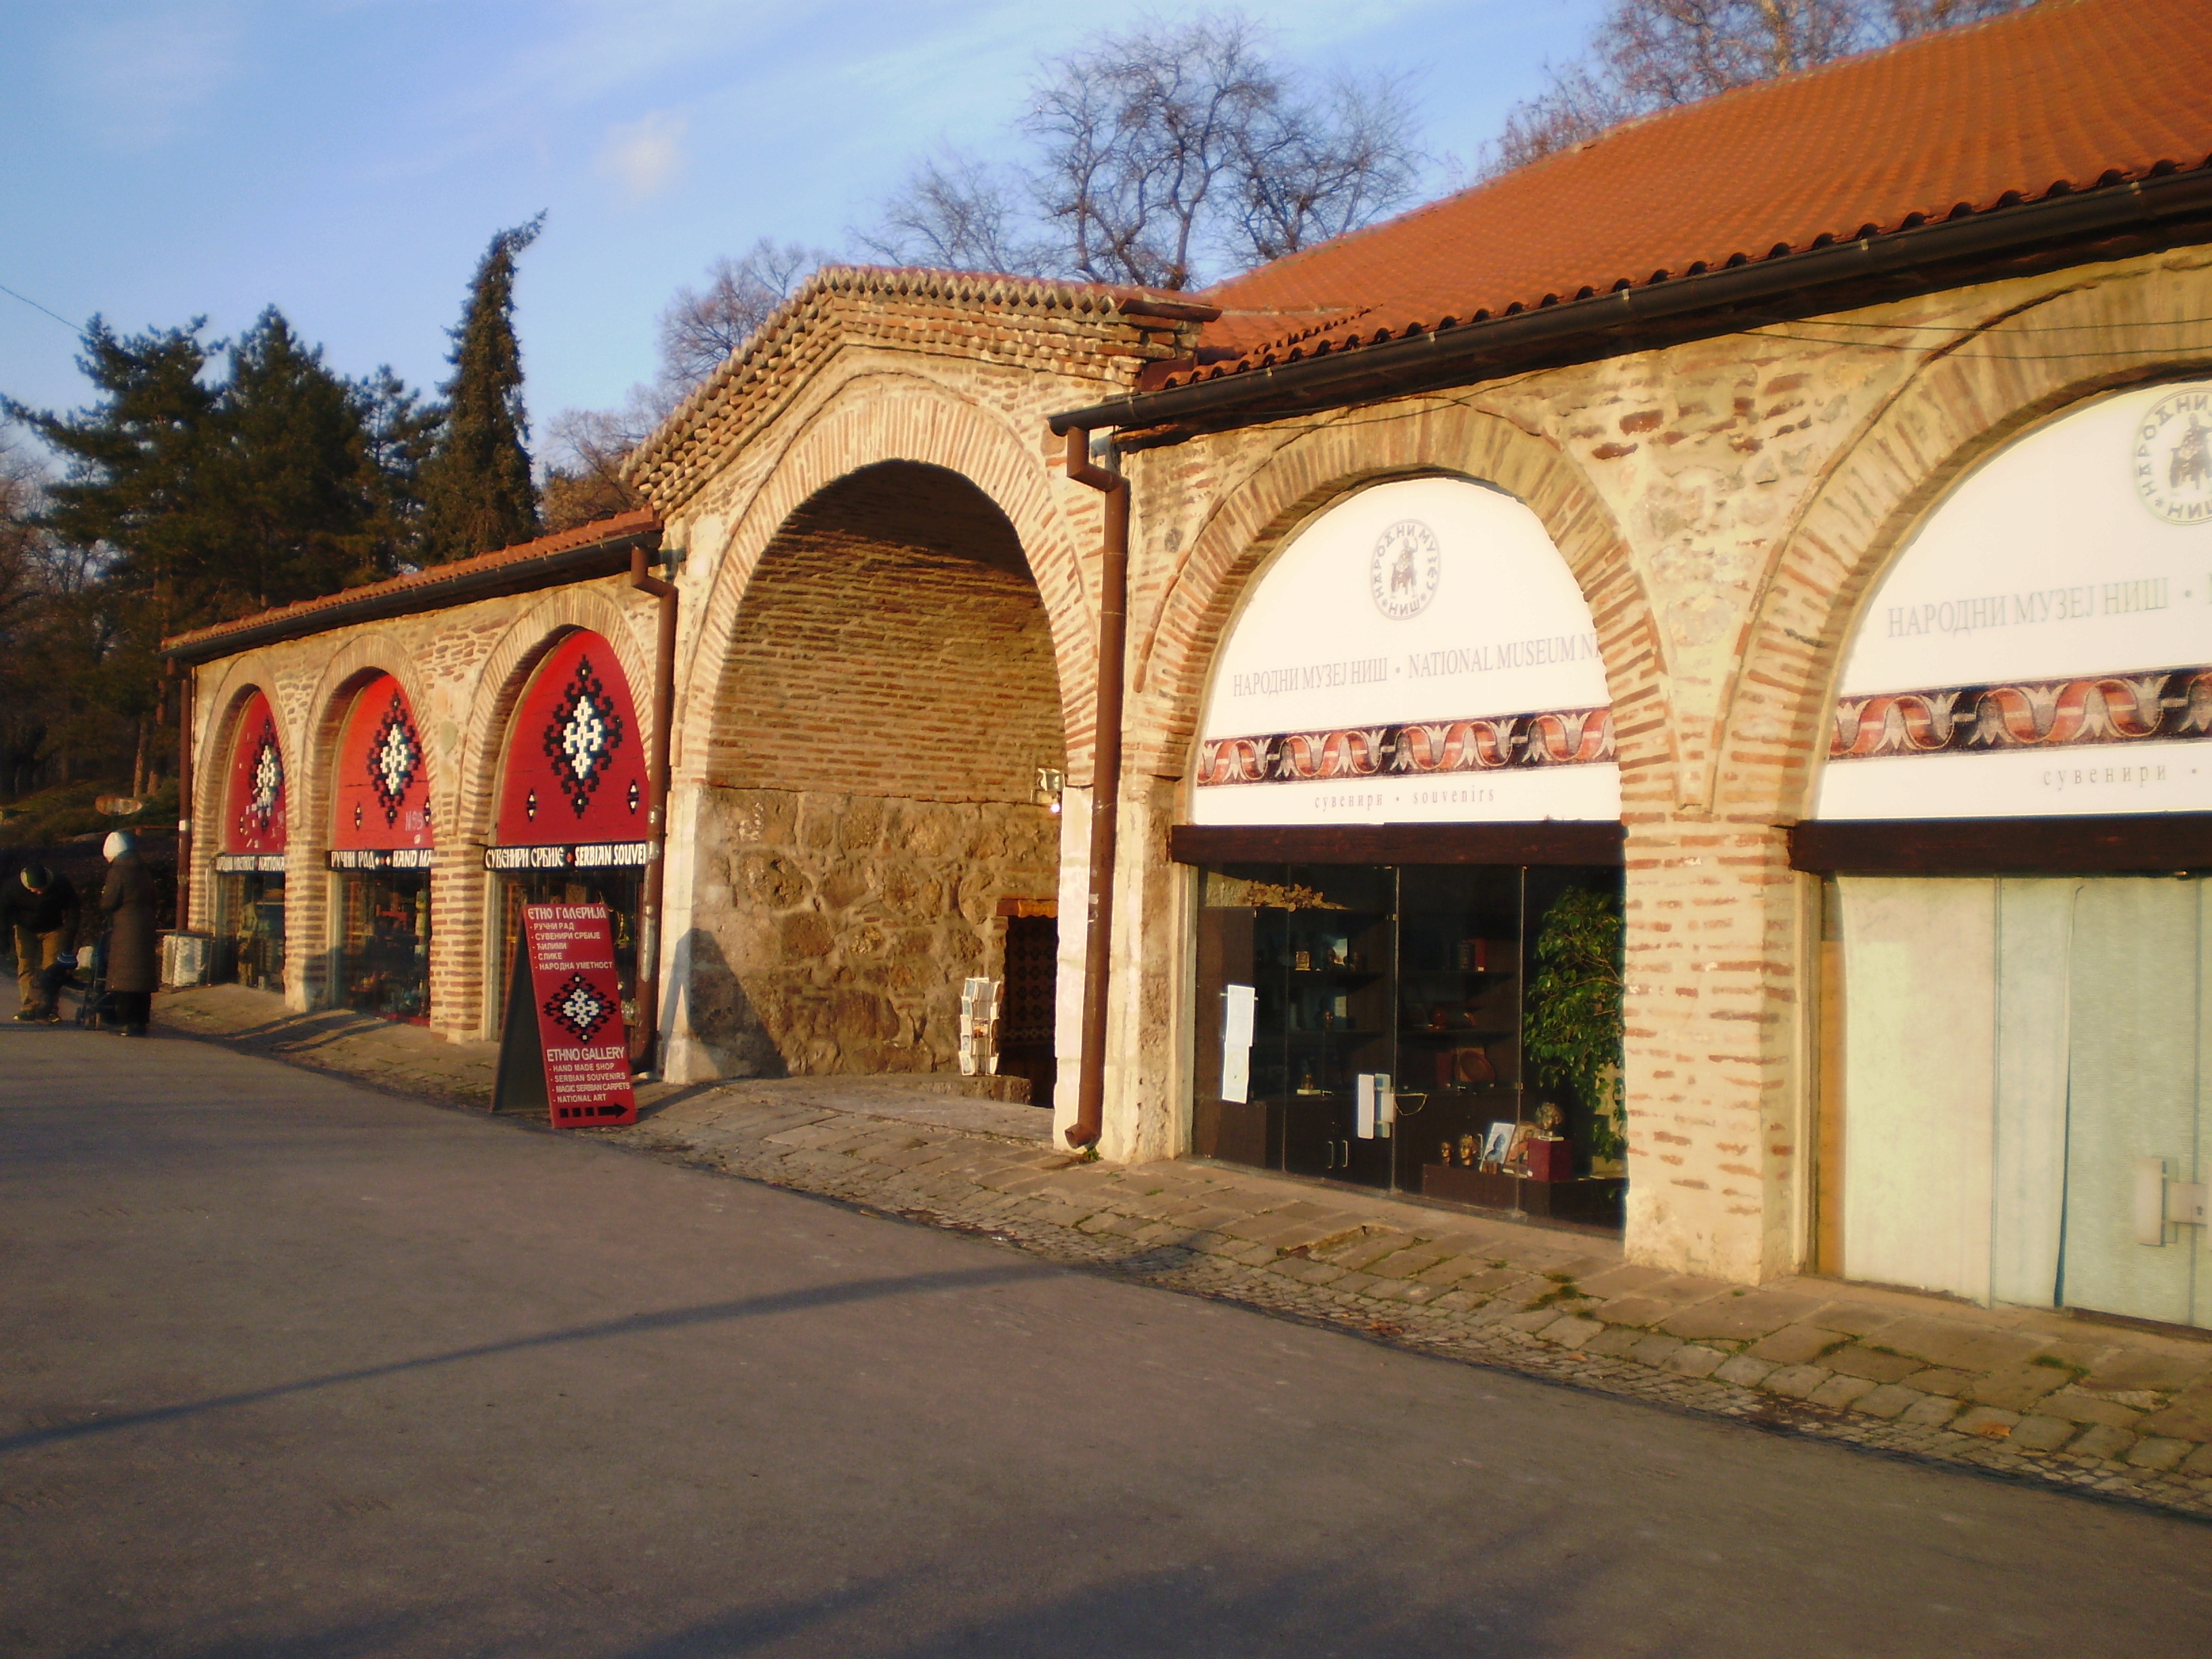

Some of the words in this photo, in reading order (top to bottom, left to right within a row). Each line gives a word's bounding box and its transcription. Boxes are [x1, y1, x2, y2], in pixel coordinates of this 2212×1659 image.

[1887, 595, 2007, 639] НАРОДНИ
[2013, 586, 2095, 626] МУЗЕЈ
[2102, 577, 2169, 615] НИШ
[1408, 646, 1493, 678] NATIONAL
[1497, 635, 1576, 670] MUSEUM
[1233, 668, 1299, 697] НАРОДНИ
[1303, 662, 1347, 689] МУЗЕЈ
[1351, 657, 1388, 684] НИШ
[2044, 765, 2166, 791] сувенири
[1315, 794, 1382, 812] сувенири
[1413, 785, 1494, 804] souvenirs
[358, 851, 375, 870] РАД
[392, 849, 417, 867] HAND
[485, 848, 529, 868] СУВЕНИРИ
[531, 846, 563, 867] СРБИЈЕ
[575, 845, 611, 867] SERBIAN
[528, 907, 553, 920] ЕТНО
[555, 907, 607, 920] ГАЛЕРИЈА
[558, 922, 575, 930] РАД
[546, 1048, 580, 1062] ETHNO
[581, 1046, 625, 1061] GALLERY
[553, 1064, 573, 1072] HAND
[554, 1074, 585, 1082] SERBIAN
[586, 1072, 626, 1081] SOUVENIRS
[557, 1094, 592, 1103] NATIONAL
[593, 1093, 607, 1101] ART
